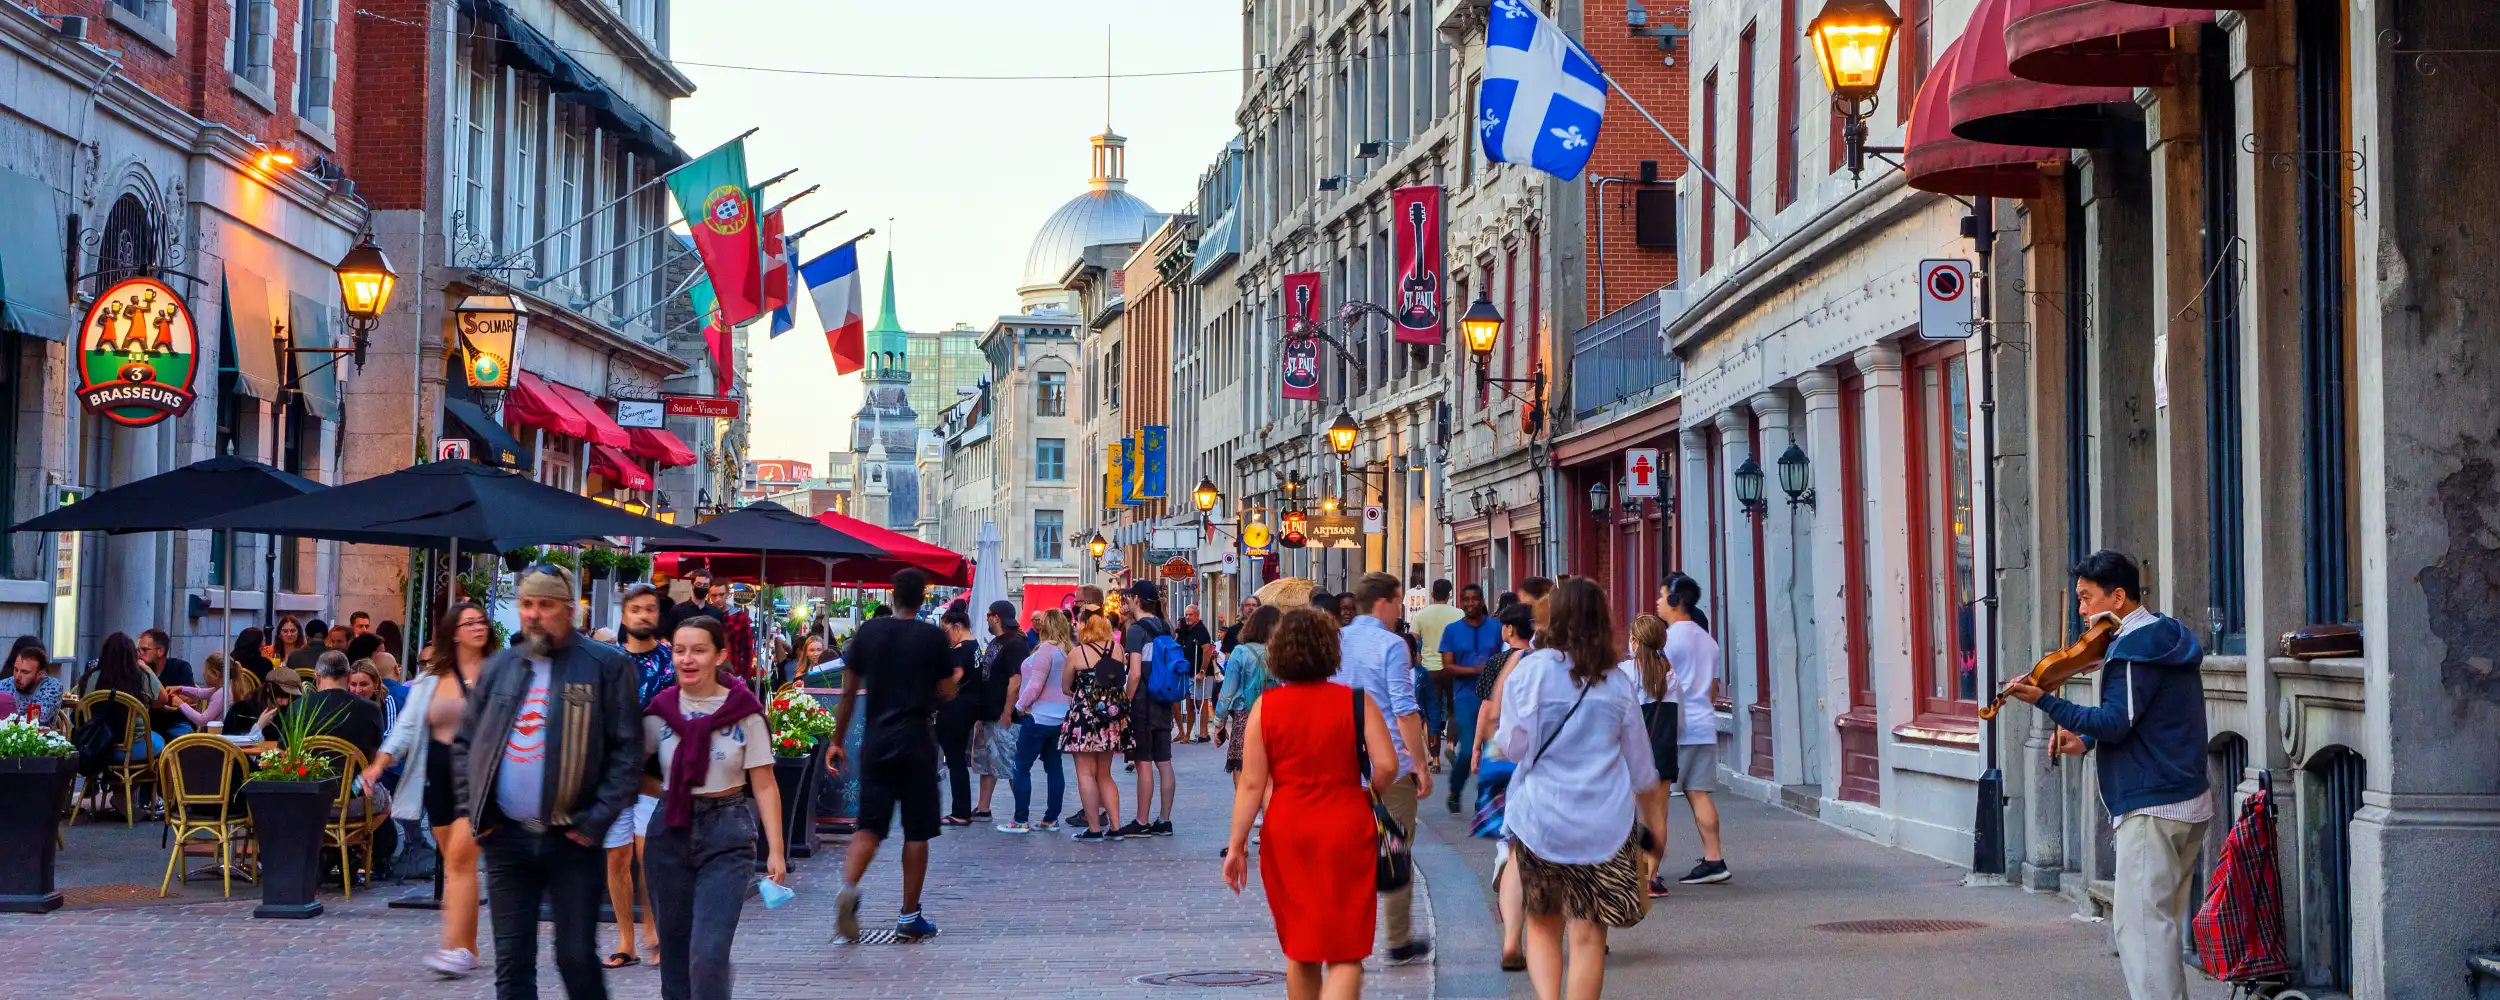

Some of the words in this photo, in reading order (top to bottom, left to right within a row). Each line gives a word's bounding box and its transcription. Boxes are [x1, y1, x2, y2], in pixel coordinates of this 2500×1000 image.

[1415, 291, 1436, 317] PAUL
[128, 353, 149, 361] LES
[131, 367, 143, 381] 3
[1298, 357, 1316, 378] PAUL
[89, 386, 183, 408] BRASSEURS
[672, 403, 728, 415] Saint-Vincent
[1312, 526, 1356, 537] ARTISANS
[1245, 547, 1270, 556] Amber
